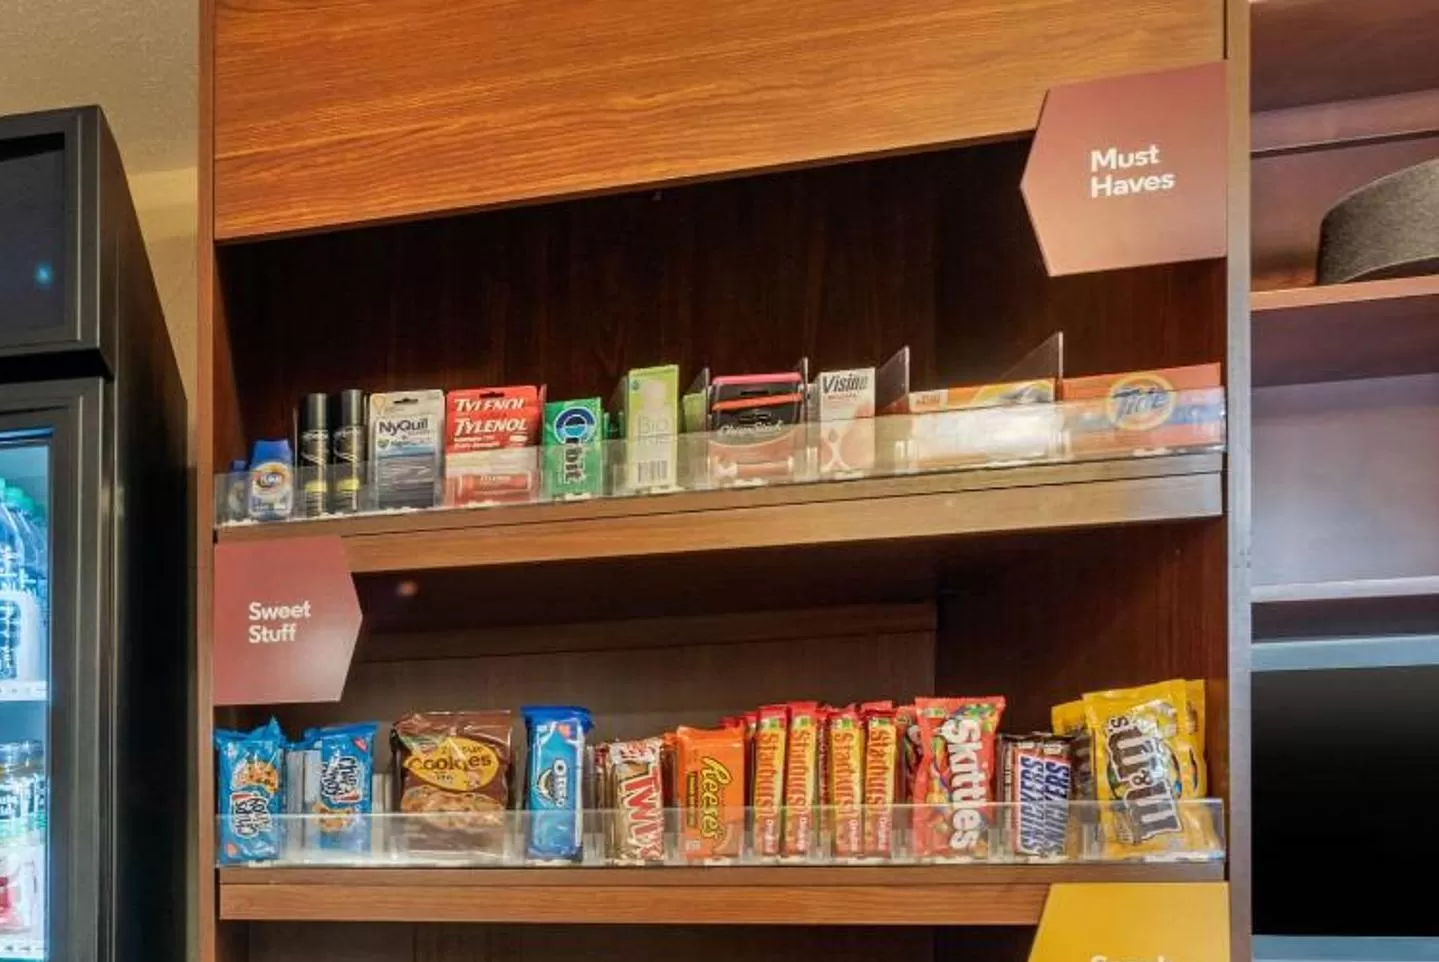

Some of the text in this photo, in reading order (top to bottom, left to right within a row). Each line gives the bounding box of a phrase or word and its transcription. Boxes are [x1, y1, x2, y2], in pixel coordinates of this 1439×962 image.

[1091, 144, 1160, 172] Must
[1091, 173, 1176, 198] Haves
[378, 418, 429, 437] NyQuil
[454, 418, 528, 436] TYLENOL
[248, 600, 311, 621] Sweet
[248, 623, 297, 644] Stuff
